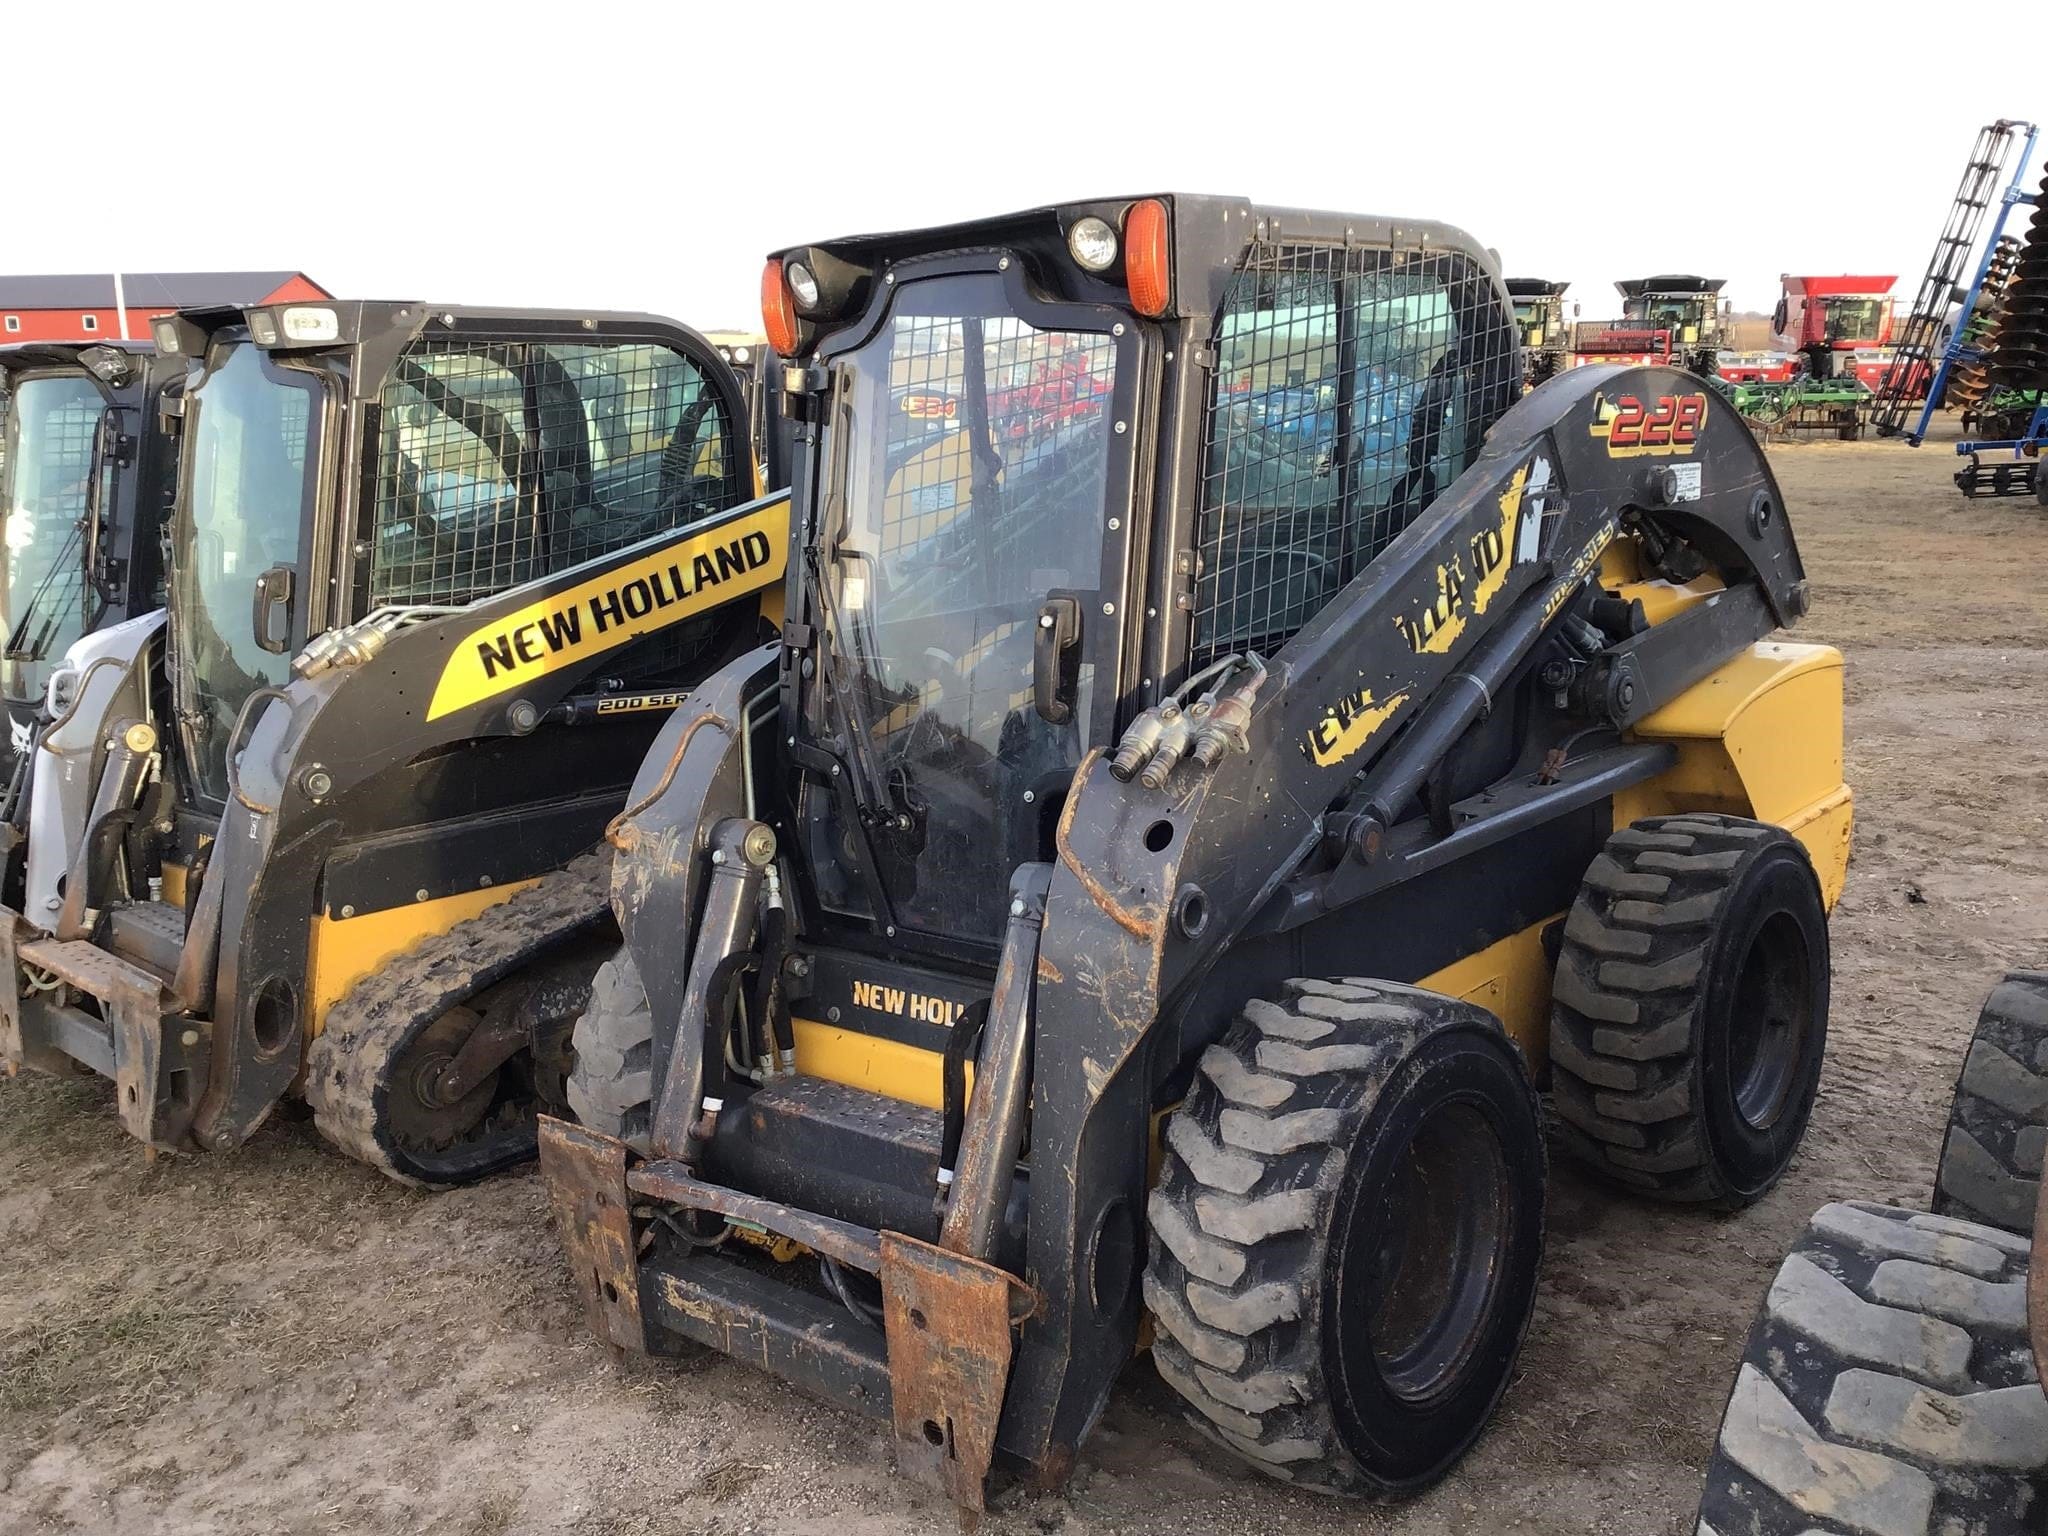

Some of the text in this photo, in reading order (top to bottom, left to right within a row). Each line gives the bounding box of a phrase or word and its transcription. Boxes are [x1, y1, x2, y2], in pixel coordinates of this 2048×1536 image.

[477, 530, 771, 680] NEW HOLLAND
[600, 698, 643, 711] 200
[853, 980, 906, 1016] NEW
